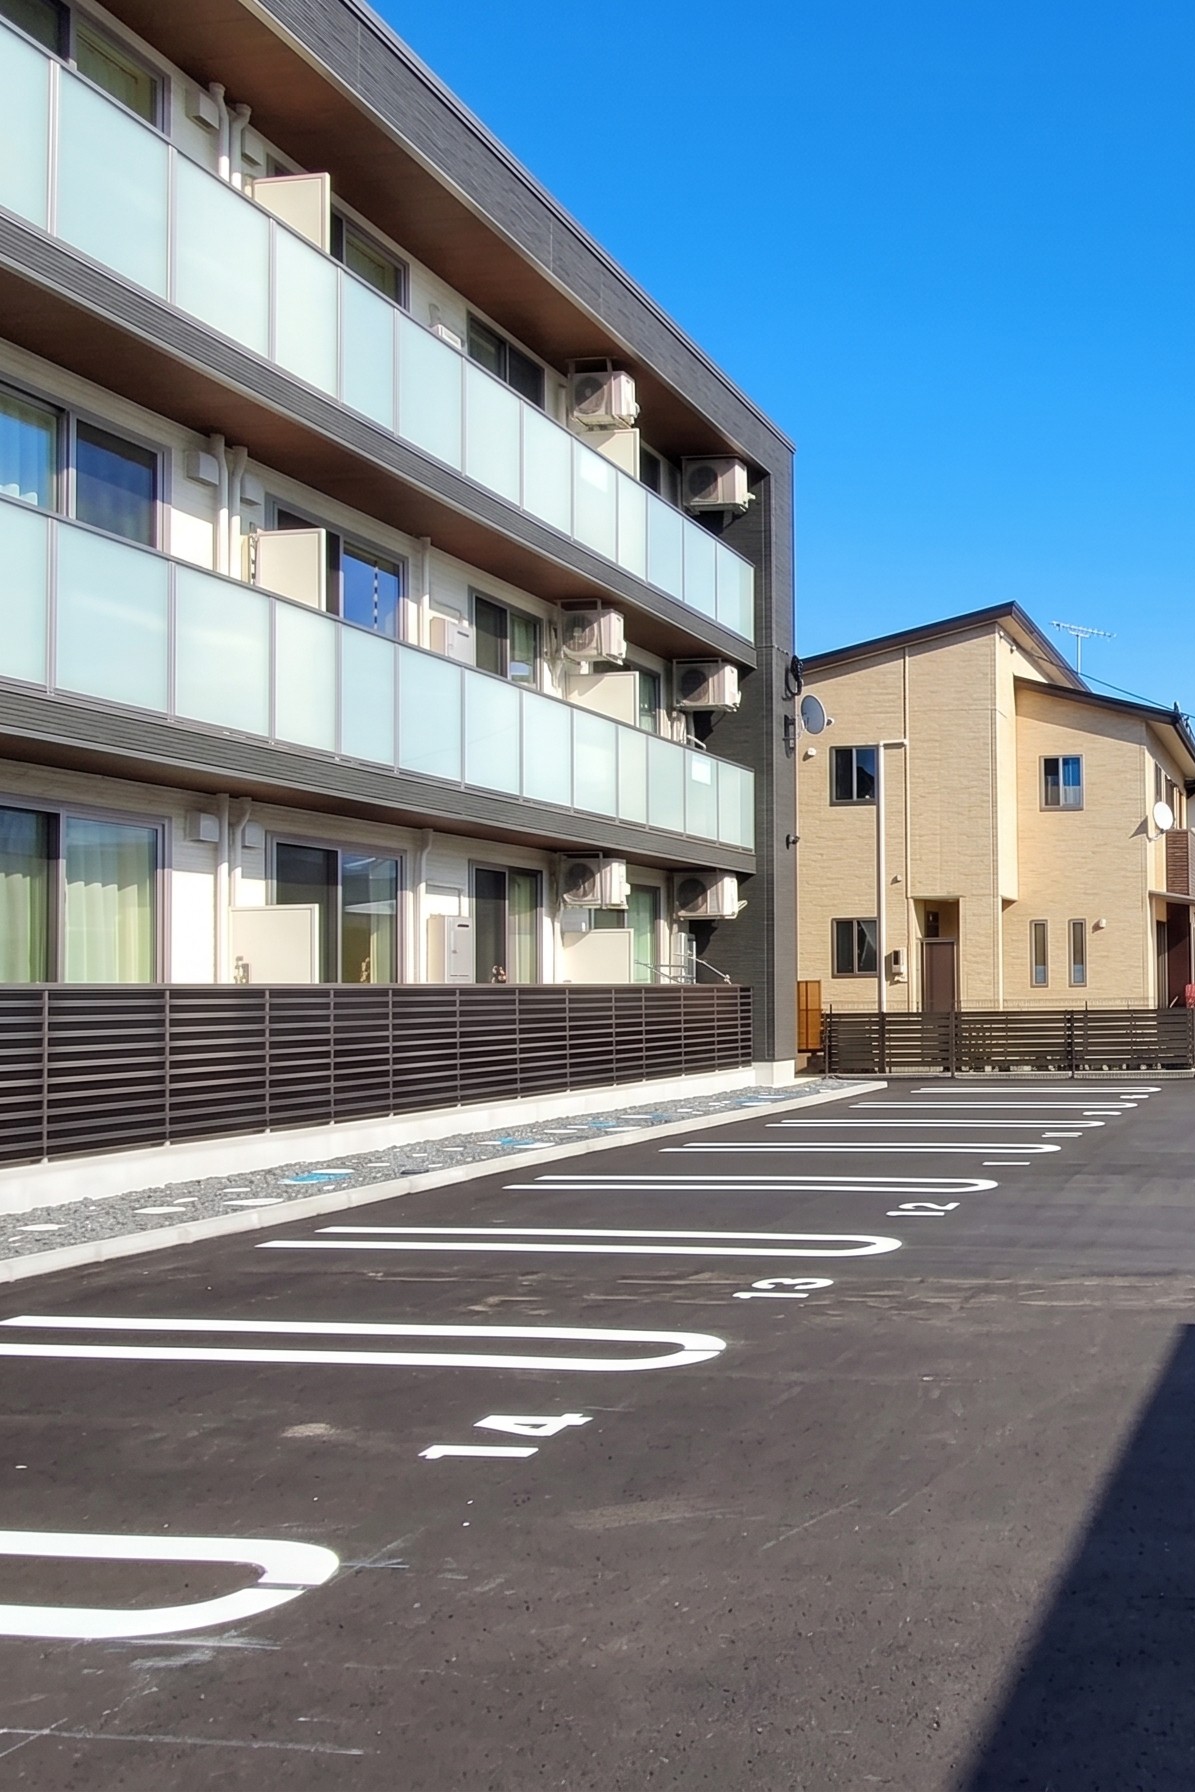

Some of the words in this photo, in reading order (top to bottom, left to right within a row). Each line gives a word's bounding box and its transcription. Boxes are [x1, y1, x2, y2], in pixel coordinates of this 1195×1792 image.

[886, 1202, 961, 1217] 12
[732, 1277, 835, 1299] 13
[417, 1413, 593, 1460] 14
